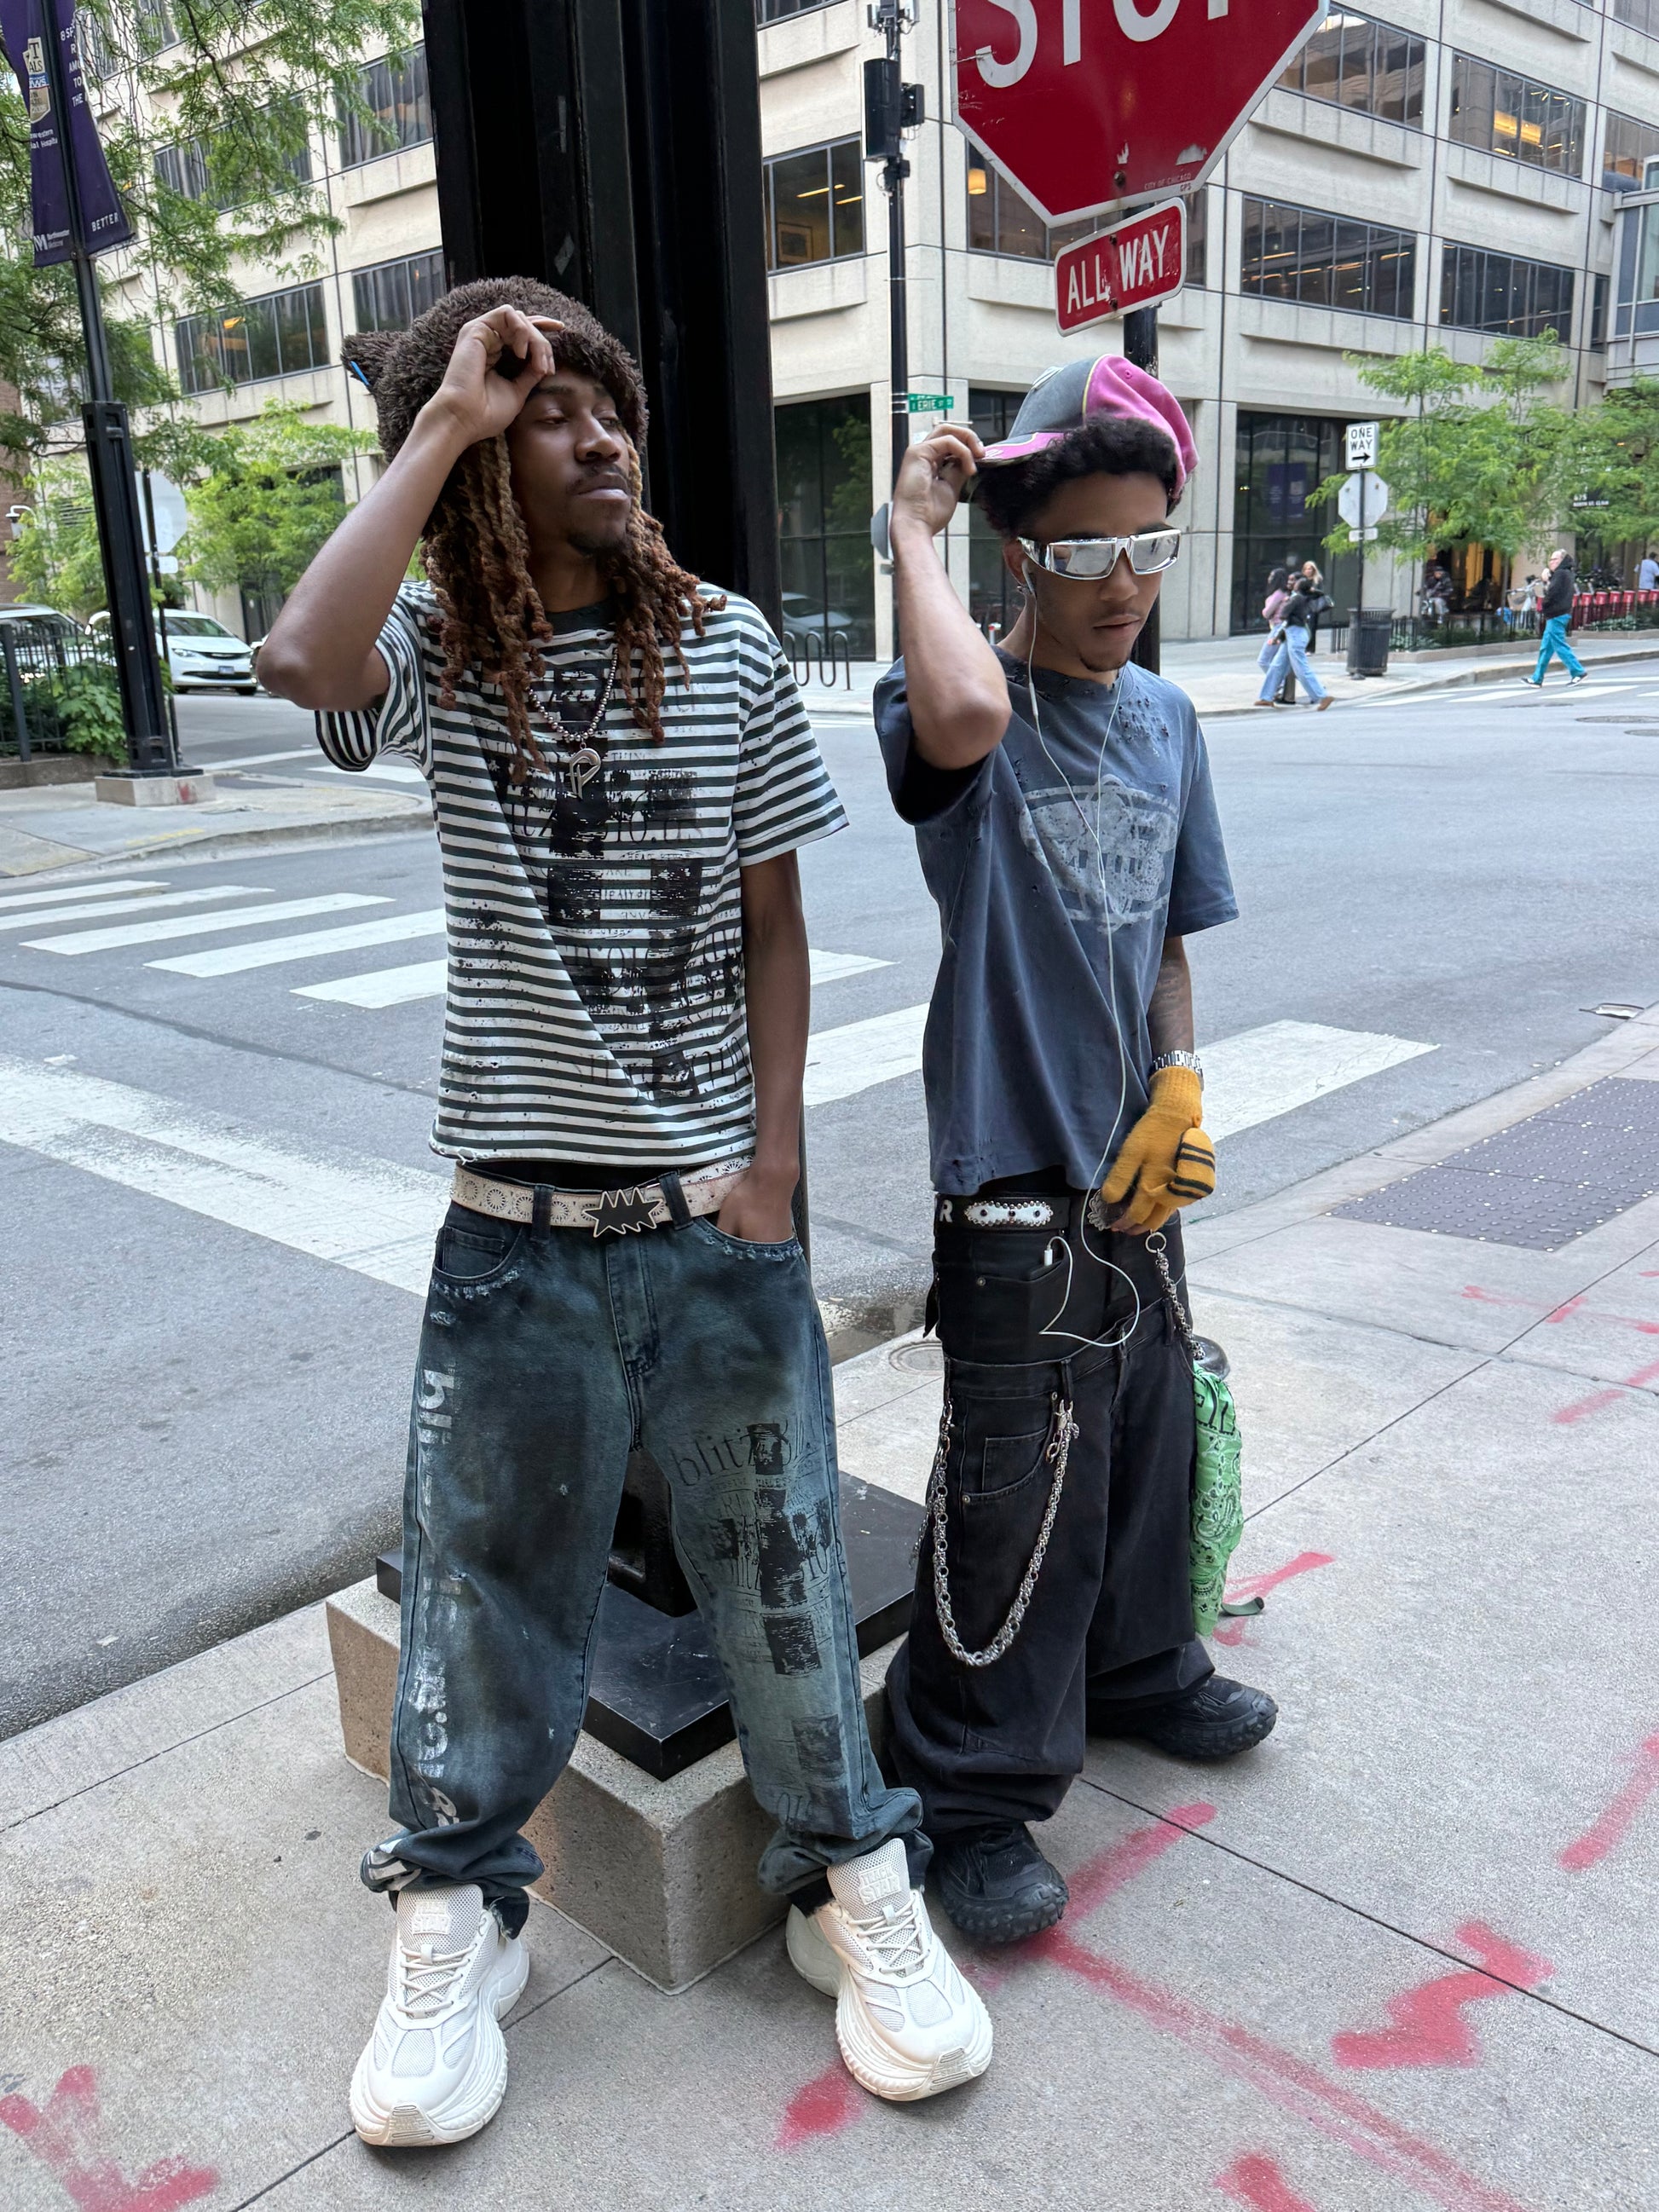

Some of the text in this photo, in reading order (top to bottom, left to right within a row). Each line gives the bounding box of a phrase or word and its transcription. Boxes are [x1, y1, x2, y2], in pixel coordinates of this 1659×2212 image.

[91, 212, 119, 232] BETTER
[1066, 225, 1170, 315] ALL WAY
[917, 399, 937, 411] ERIE
[1350, 428, 1373, 439] ONE
[1350, 440, 1373, 451] WAY
[860, 1877, 899, 1903] STAR
